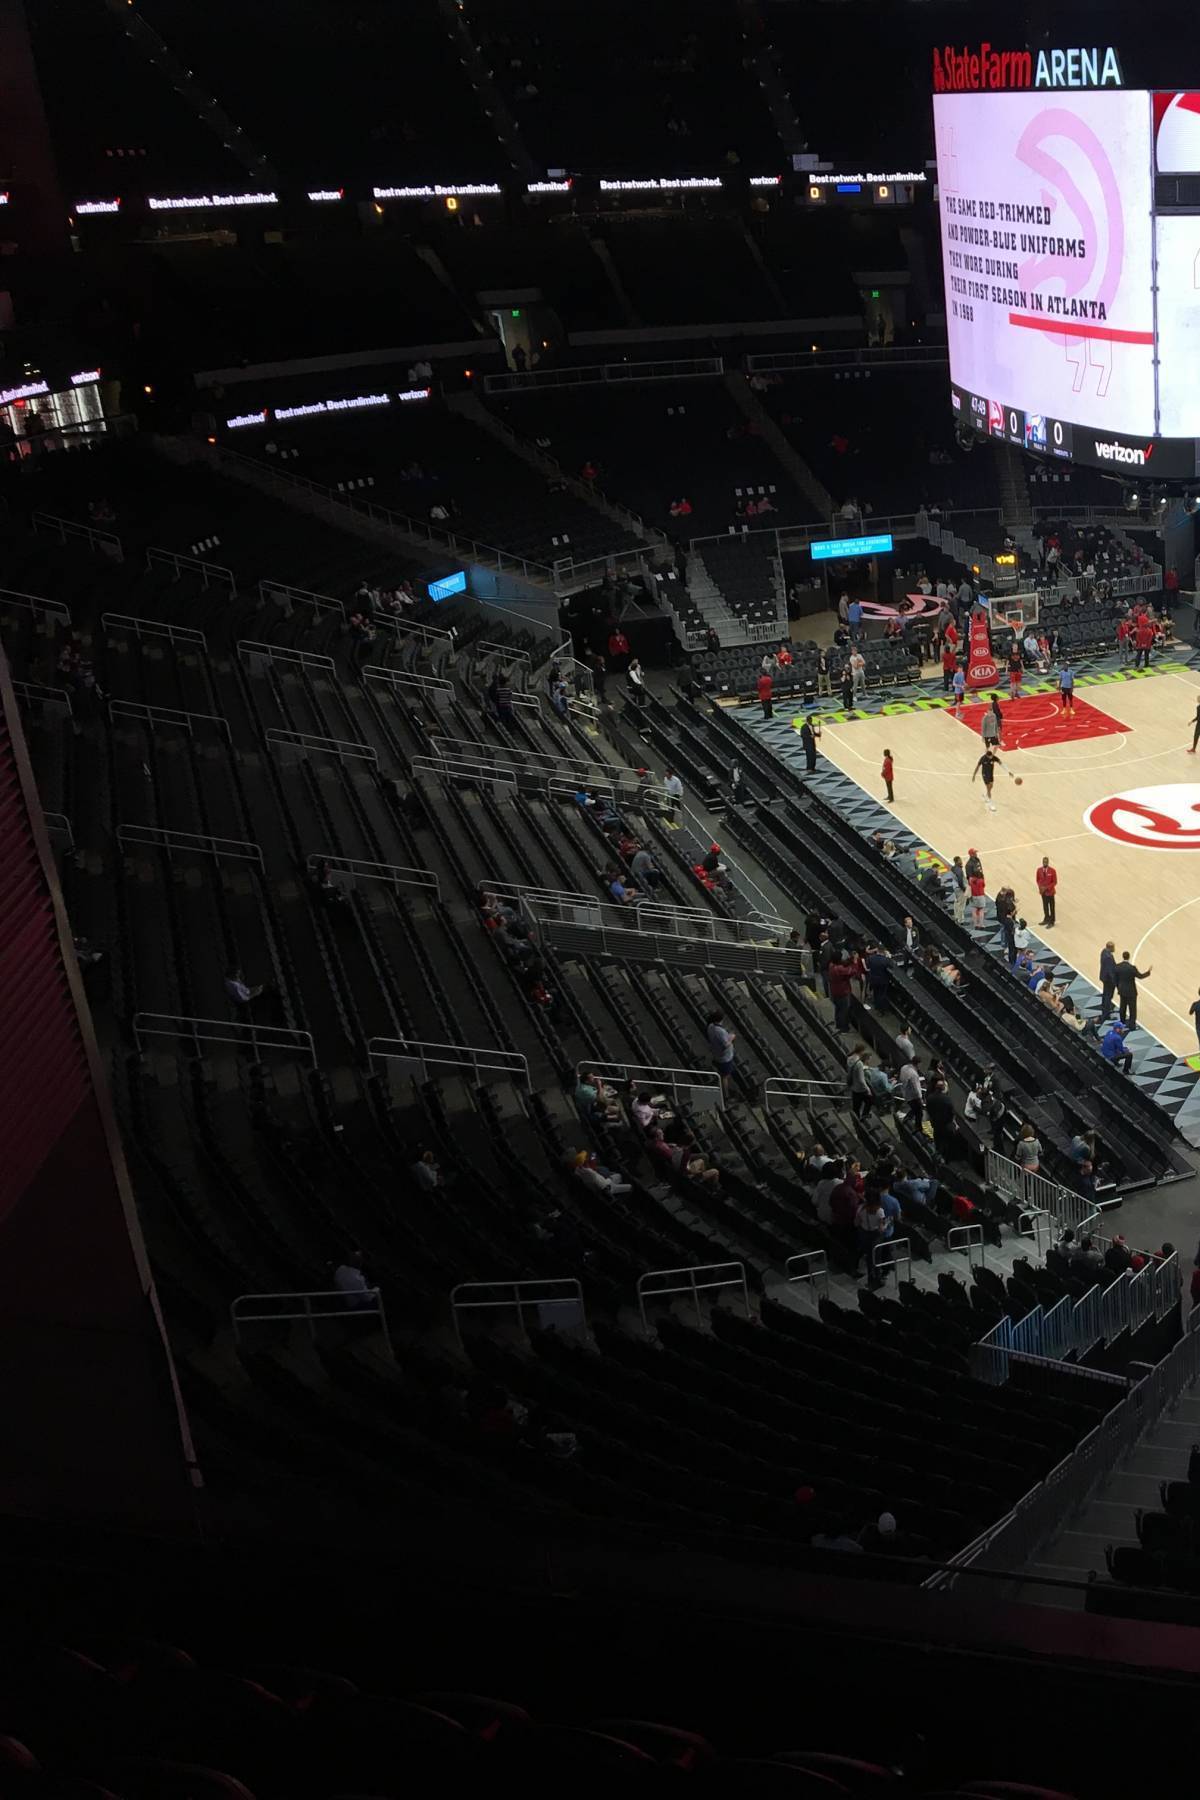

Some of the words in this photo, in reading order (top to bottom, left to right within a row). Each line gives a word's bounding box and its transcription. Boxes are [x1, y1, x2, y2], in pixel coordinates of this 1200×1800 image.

[1035, 47, 1121, 87] ARENA
[600, 180, 621, 189] Best
[621, 179, 660, 188] network.
[660, 178, 680, 187] Best
[680, 177, 722, 187] unlimited.
[750, 176, 779, 185] verizon
[809, 174, 827, 183] Best
[827, 173, 866, 183] network.
[866, 172, 884, 182] Best
[885, 171, 926, 181] unlimited.
[373, 187, 396, 198] Best
[396, 186, 434, 197] network.
[435, 184, 456, 194] Best
[456, 183, 501, 194] unlimited.
[528, 180, 569, 191] unlimited
[149, 198, 173, 209] Best
[173, 197, 212, 207] network.
[213, 194, 234, 206] Best
[234, 192, 278, 204] unlimited.
[308, 190, 341, 200] verizon
[76, 201, 119, 213] unlimited
[946, 196, 957, 214] THE
[958, 197, 977, 217] SAME
[979, 200, 1051, 226] RED-TRIMMED
[948, 222, 959, 241] AND
[960, 224, 1017, 251] POWDER-BLUE
[1020, 233, 1086, 258] UNIFORMS
[964, 254, 984, 274] WORE
[985, 258, 1019, 280] DURING
[968, 280, 988, 301] FIRST
[991, 286, 1027, 309] SEASON
[1030, 292, 1043, 311] IN
[1047, 295, 1107, 320] ATLANTA
[399, 390, 428, 401] verizon
[275, 408, 293, 420] Best
[293, 402, 326, 416] network.
[327, 399, 347, 410] Best
[347, 394, 390, 407] unlimited.
[227, 412, 266, 428] unlimited
[1010, 411, 1018, 434] 0
[1053, 421, 1063, 446] 0
[1095, 442, 1145, 465] verizon
[974, 667, 992, 678] KIA
